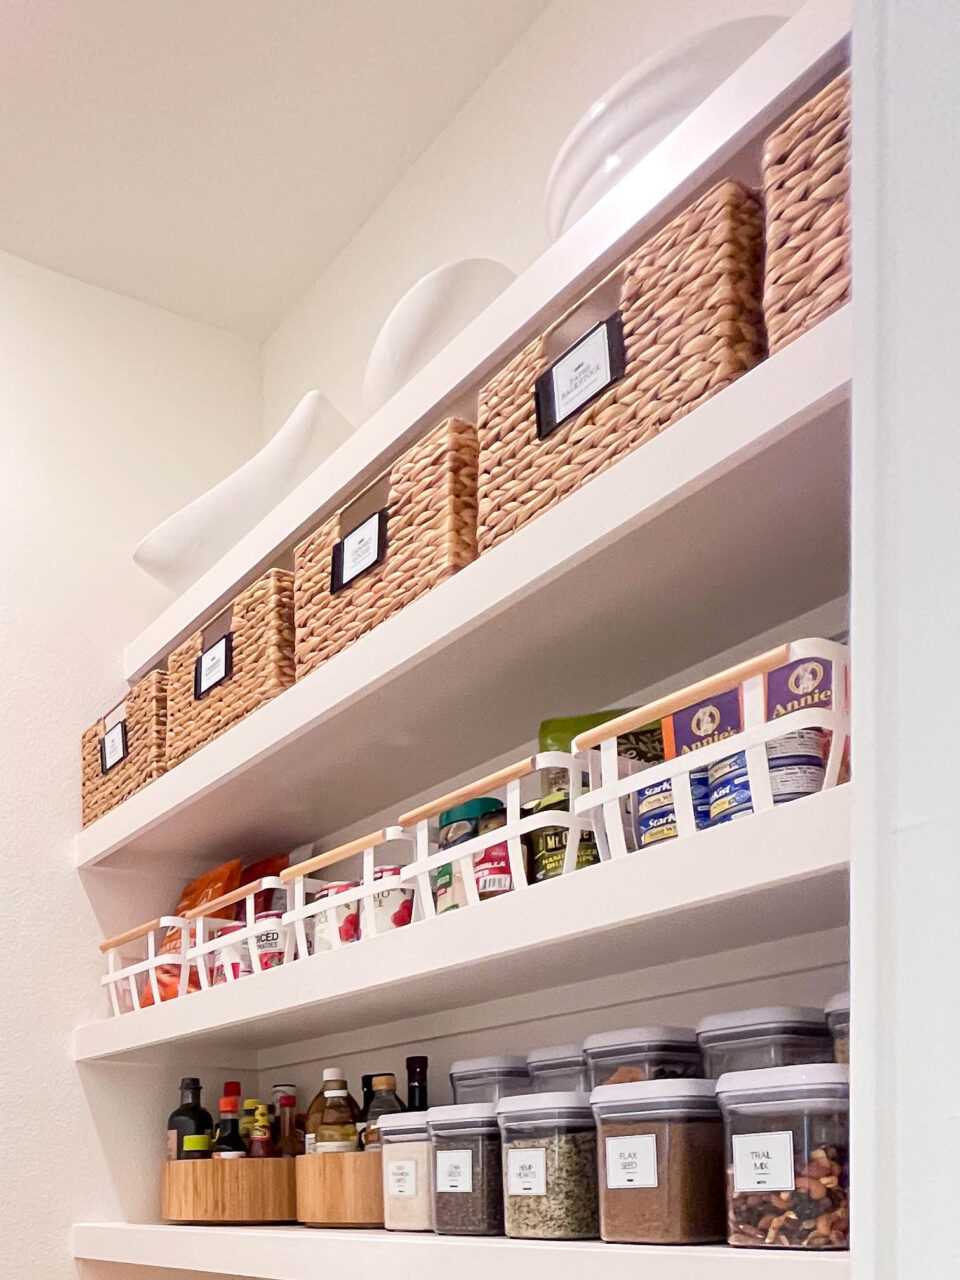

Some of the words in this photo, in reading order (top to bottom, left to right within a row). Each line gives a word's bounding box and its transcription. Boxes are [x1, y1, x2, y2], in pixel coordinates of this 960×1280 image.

[619, 1152, 638, 1160] FLAX
[750, 1151, 772, 1160] TRAIL
[753, 1162, 769, 1171] MIX
